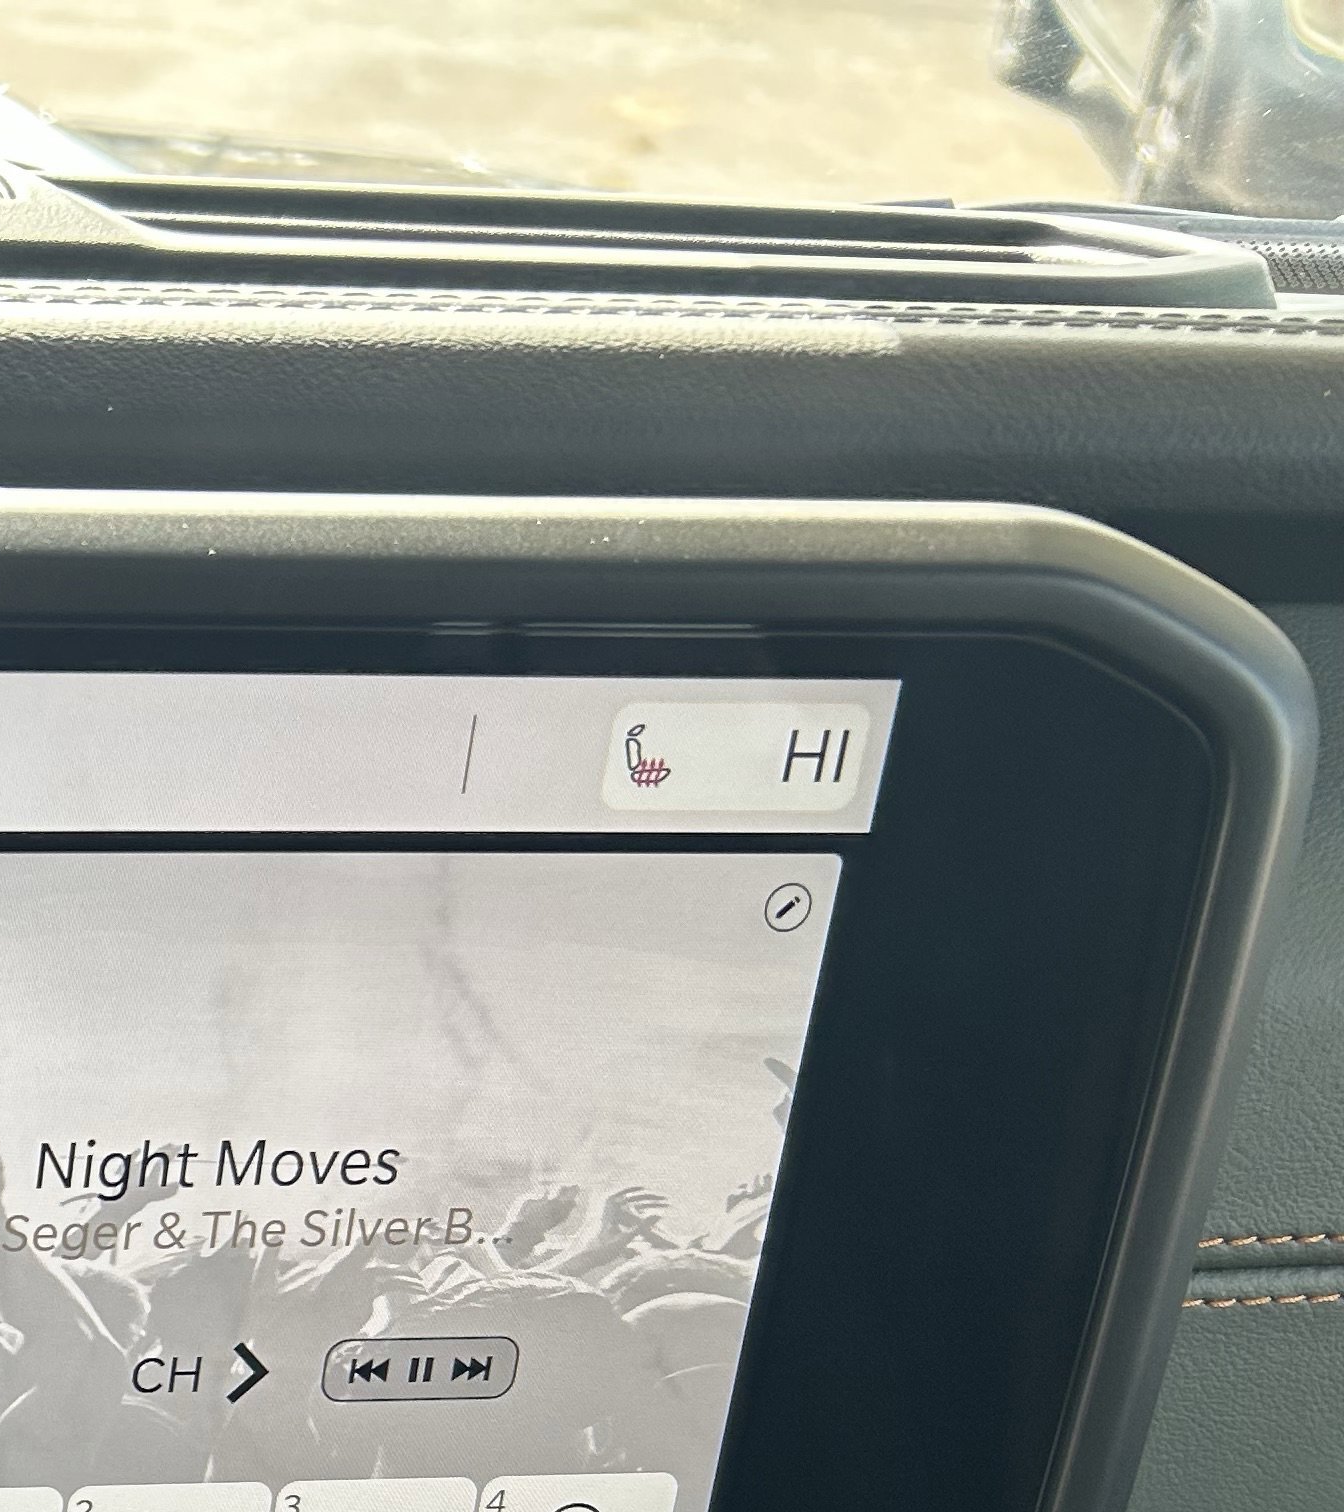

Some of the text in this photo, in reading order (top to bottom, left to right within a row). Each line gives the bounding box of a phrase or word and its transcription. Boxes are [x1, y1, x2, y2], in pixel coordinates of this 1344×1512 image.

[782, 729, 850, 783] HI
[35, 1139, 401, 1201] Night Moves
[2, 1213, 141, 1260] Seger
[153, 1213, 187, 1251] &
[202, 1210, 285, 1250] The
[299, 1208, 438, 1249] Silver
[130, 1356, 202, 1394] CH
